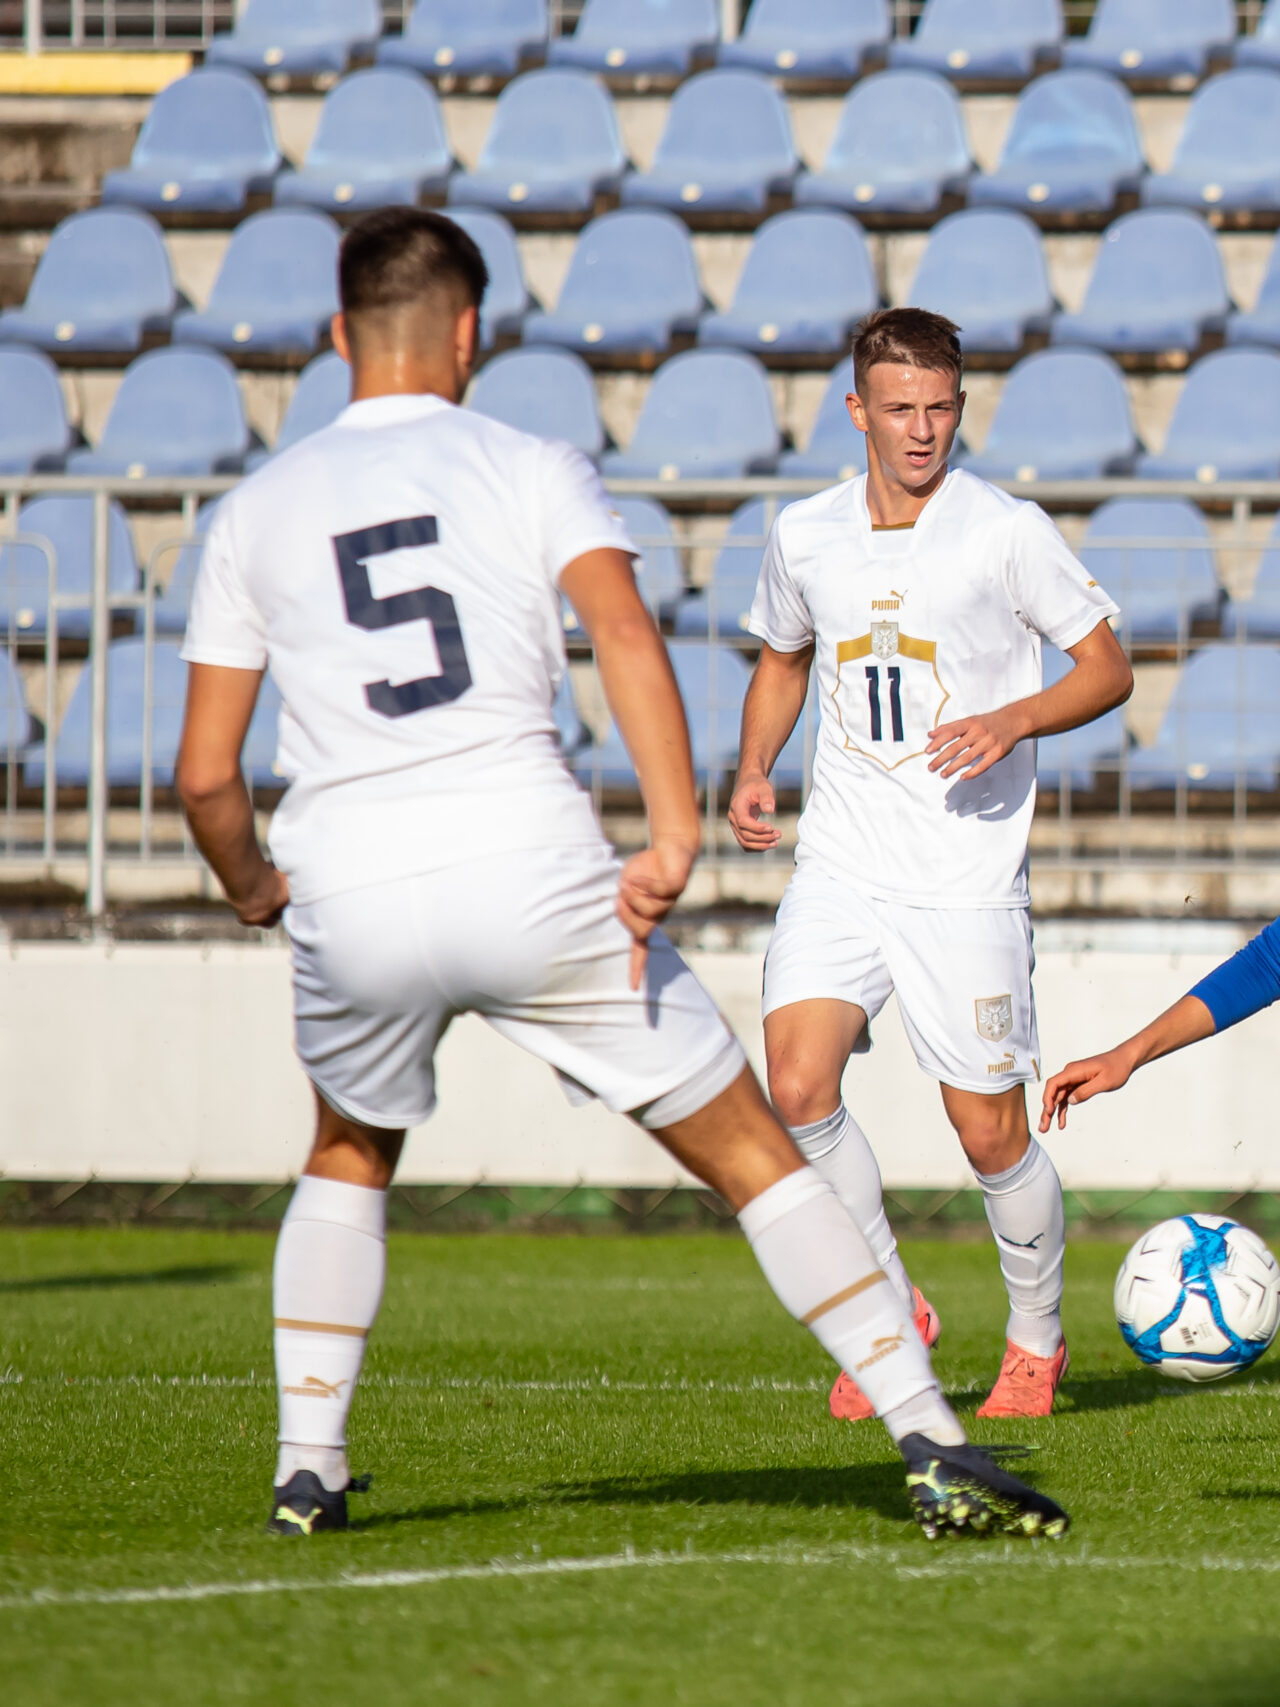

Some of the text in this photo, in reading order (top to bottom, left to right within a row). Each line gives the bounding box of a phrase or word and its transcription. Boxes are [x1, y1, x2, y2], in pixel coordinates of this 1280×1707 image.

[331, 515, 473, 719] 5
[871, 599, 900, 611] PUMA
[864, 665, 905, 742] 11
